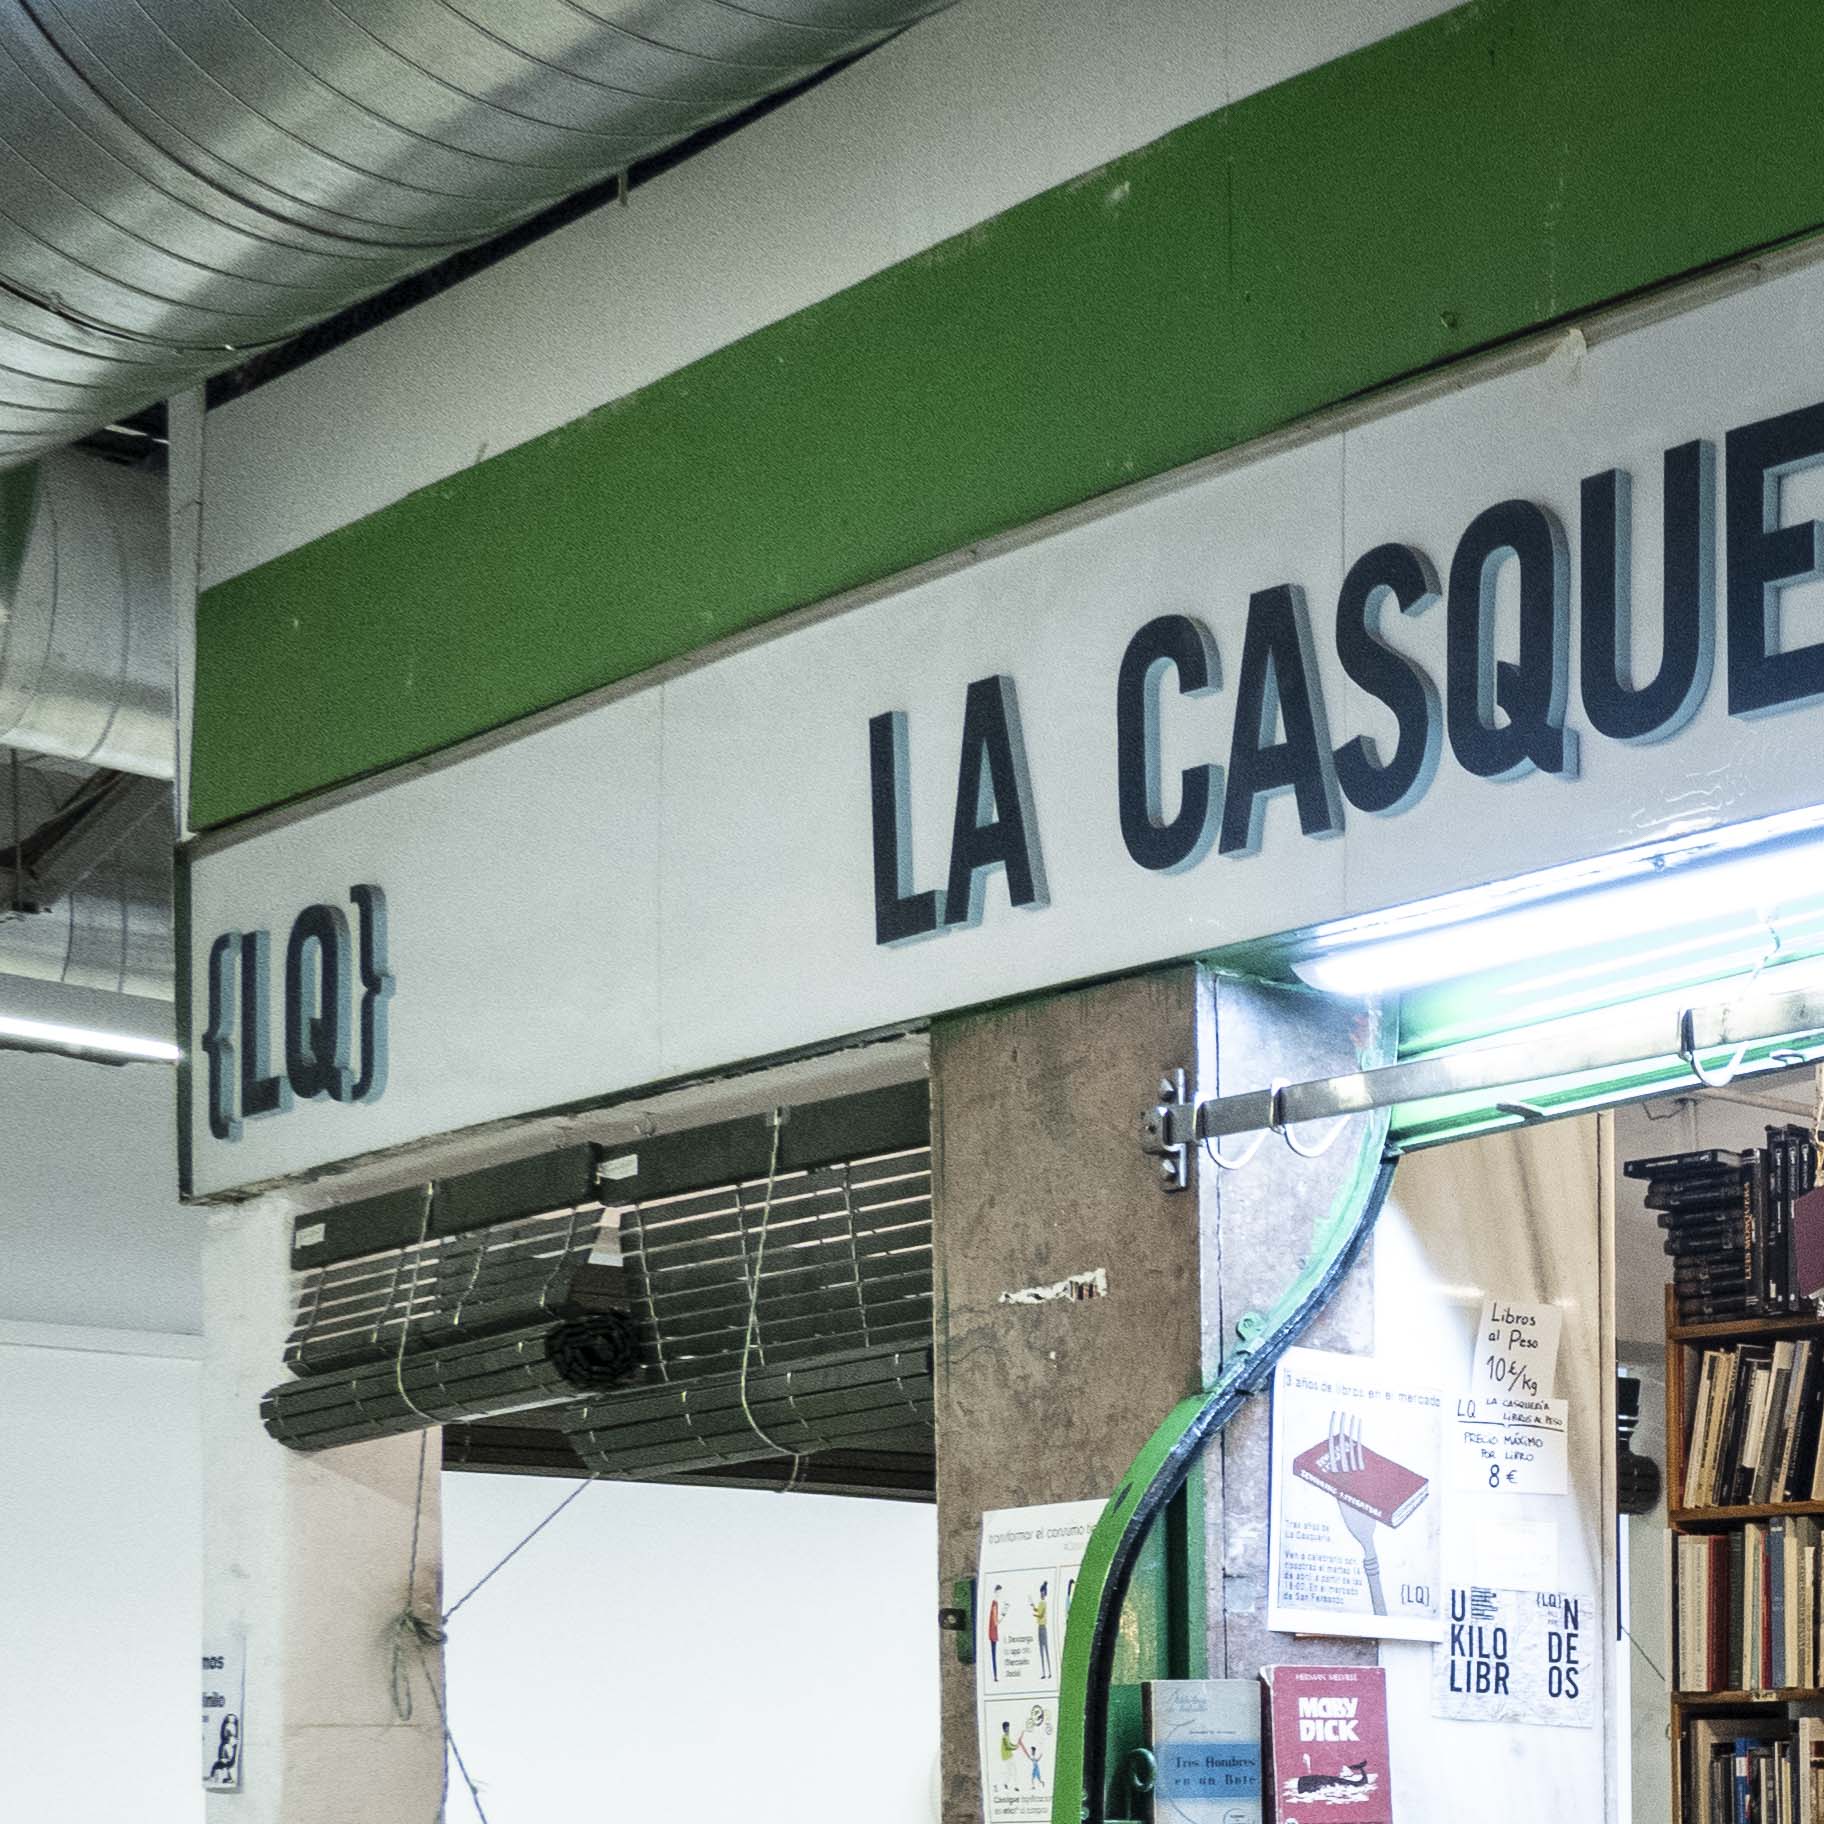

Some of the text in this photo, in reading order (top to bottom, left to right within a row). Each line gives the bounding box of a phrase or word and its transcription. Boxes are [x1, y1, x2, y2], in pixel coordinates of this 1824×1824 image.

[869, 672, 1050, 947] LA
[202, 883, 396, 1142] {LQ}
[1491, 1302, 1536, 1326] Libros
[1488, 1329, 1539, 1350] al Peso
[1489, 1464, 1518, 1488] 8 €
[1451, 1589, 1579, 1630] U N
[1451, 1624, 1579, 1664] KILO DE
[1450, 1659, 1579, 1699] LIBR OS
[1298, 1697, 1359, 1718] MOBY
[1299, 1719, 1360, 1742] DICK
[1206, 1755, 1257, 1769] Hombres
